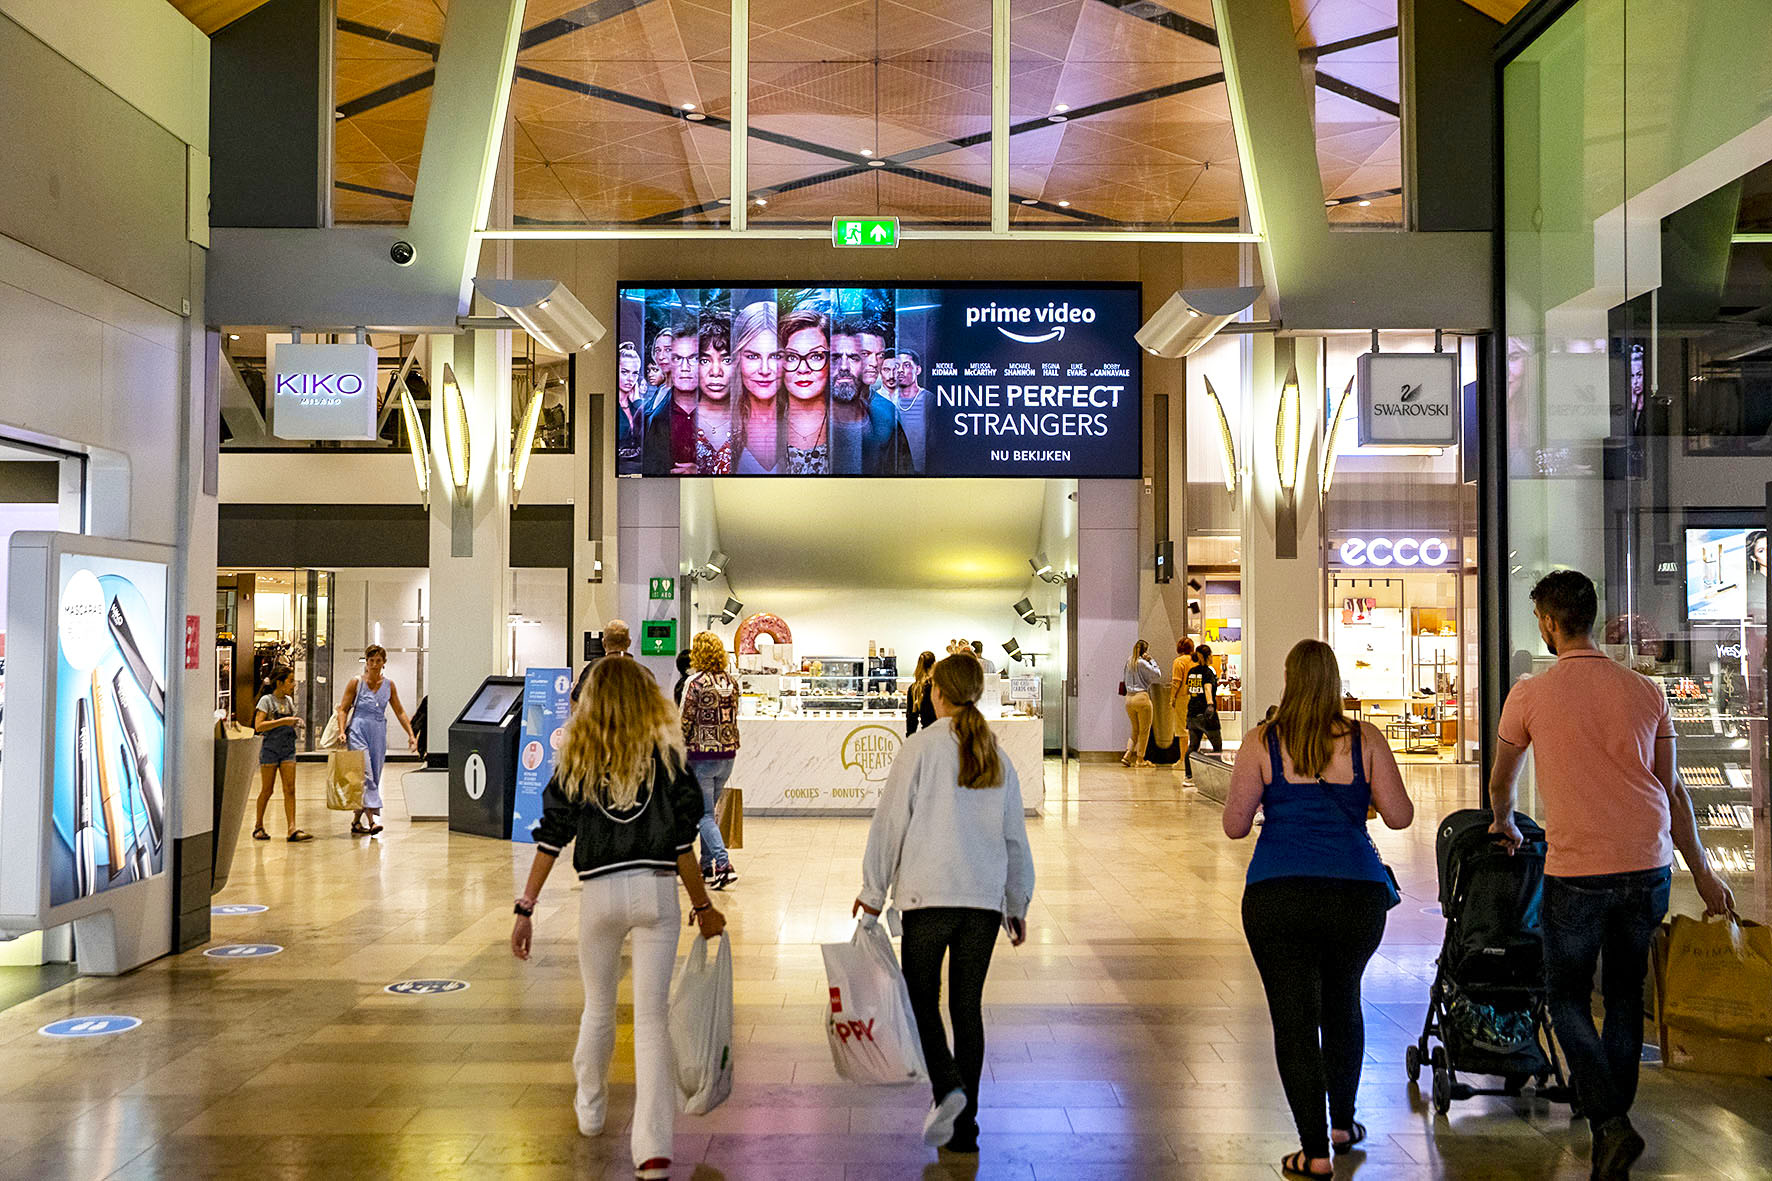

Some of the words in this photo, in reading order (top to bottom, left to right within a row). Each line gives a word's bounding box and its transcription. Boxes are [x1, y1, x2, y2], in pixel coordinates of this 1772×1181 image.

[966, 301, 1031, 327] prime
[1034, 301, 1096, 324] video
[931, 368, 958, 376] KIDMAN
[964, 368, 997, 376] McCARTHY
[1004, 369, 1036, 377] SHANNON
[1093, 369, 1130, 377] CANNAVALE
[276, 373, 363, 395] KIKO
[936, 385, 1000, 407] NINE
[1006, 385, 1125, 408] PERFECT
[1373, 404, 1449, 416] SWAROVSKI
[953, 412, 1108, 437] STRANGERS
[990, 450, 1009, 461] NU
[1013, 450, 1071, 461] BEKIJKEN
[1340, 537, 1449, 566] ecco
[855, 752, 893, 769] CHEATS
[784, 788, 820, 799] COOKIES
[832, 788, 865, 799] DONUTS
